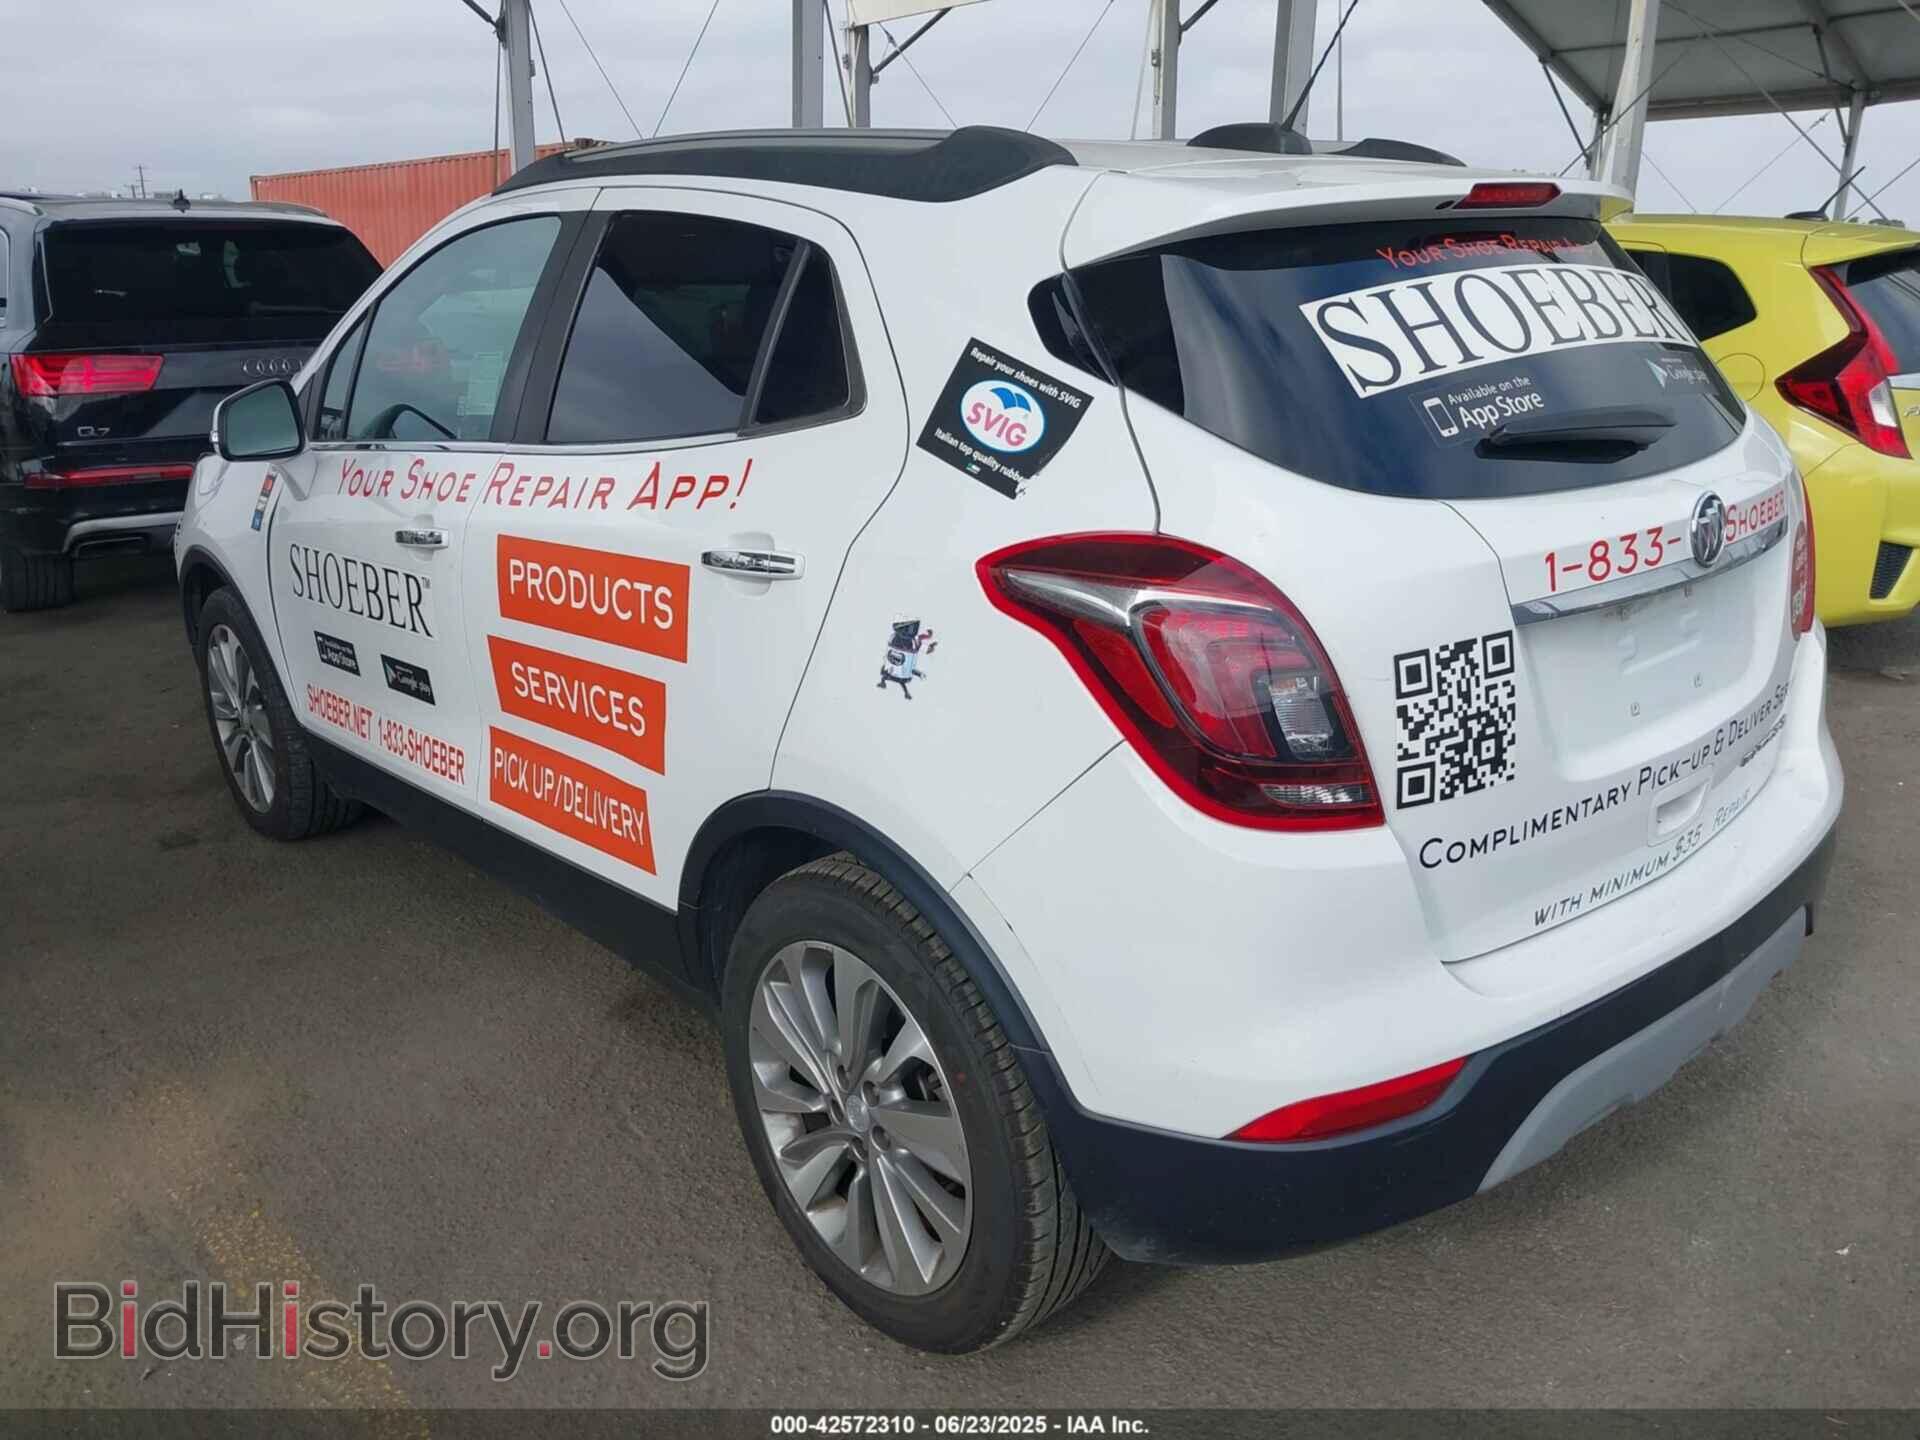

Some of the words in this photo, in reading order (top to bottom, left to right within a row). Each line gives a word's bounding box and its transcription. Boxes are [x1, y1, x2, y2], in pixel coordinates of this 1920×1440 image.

[1316, 267, 1688, 394] SHOEBER
[970, 347, 996, 367] Repair
[995, 360, 1015, 376] your
[1014, 370, 1038, 387] shoes
[1038, 380, 1059, 398] with
[1057, 391, 1082, 409] SVIG
[1447, 384, 1498, 405] Available
[1498, 381, 1514, 391] on
[1512, 376, 1531, 388] the
[77, 425, 110, 437] Q7
[934, 427, 958, 448] Italian
[958, 442, 974, 456] top
[973, 449, 1001, 472] quality
[967, 402, 1027, 447] SVIG
[289, 542, 433, 638] SHOEBER
[508, 558, 674, 631] PRODUCTS
[306, 683, 373, 738] SHOEBER.NET
[376, 716, 465, 786] 1-833-SHOEBER
[511, 661, 646, 738] SERVICES
[1714, 728, 1725, 755] &
[493, 747, 528, 793] PICK
[532, 763, 645, 846] UP/DELIVERY
[1534, 892, 1583, 928] WITH
[1588, 855, 1669, 902] MINIMUM
